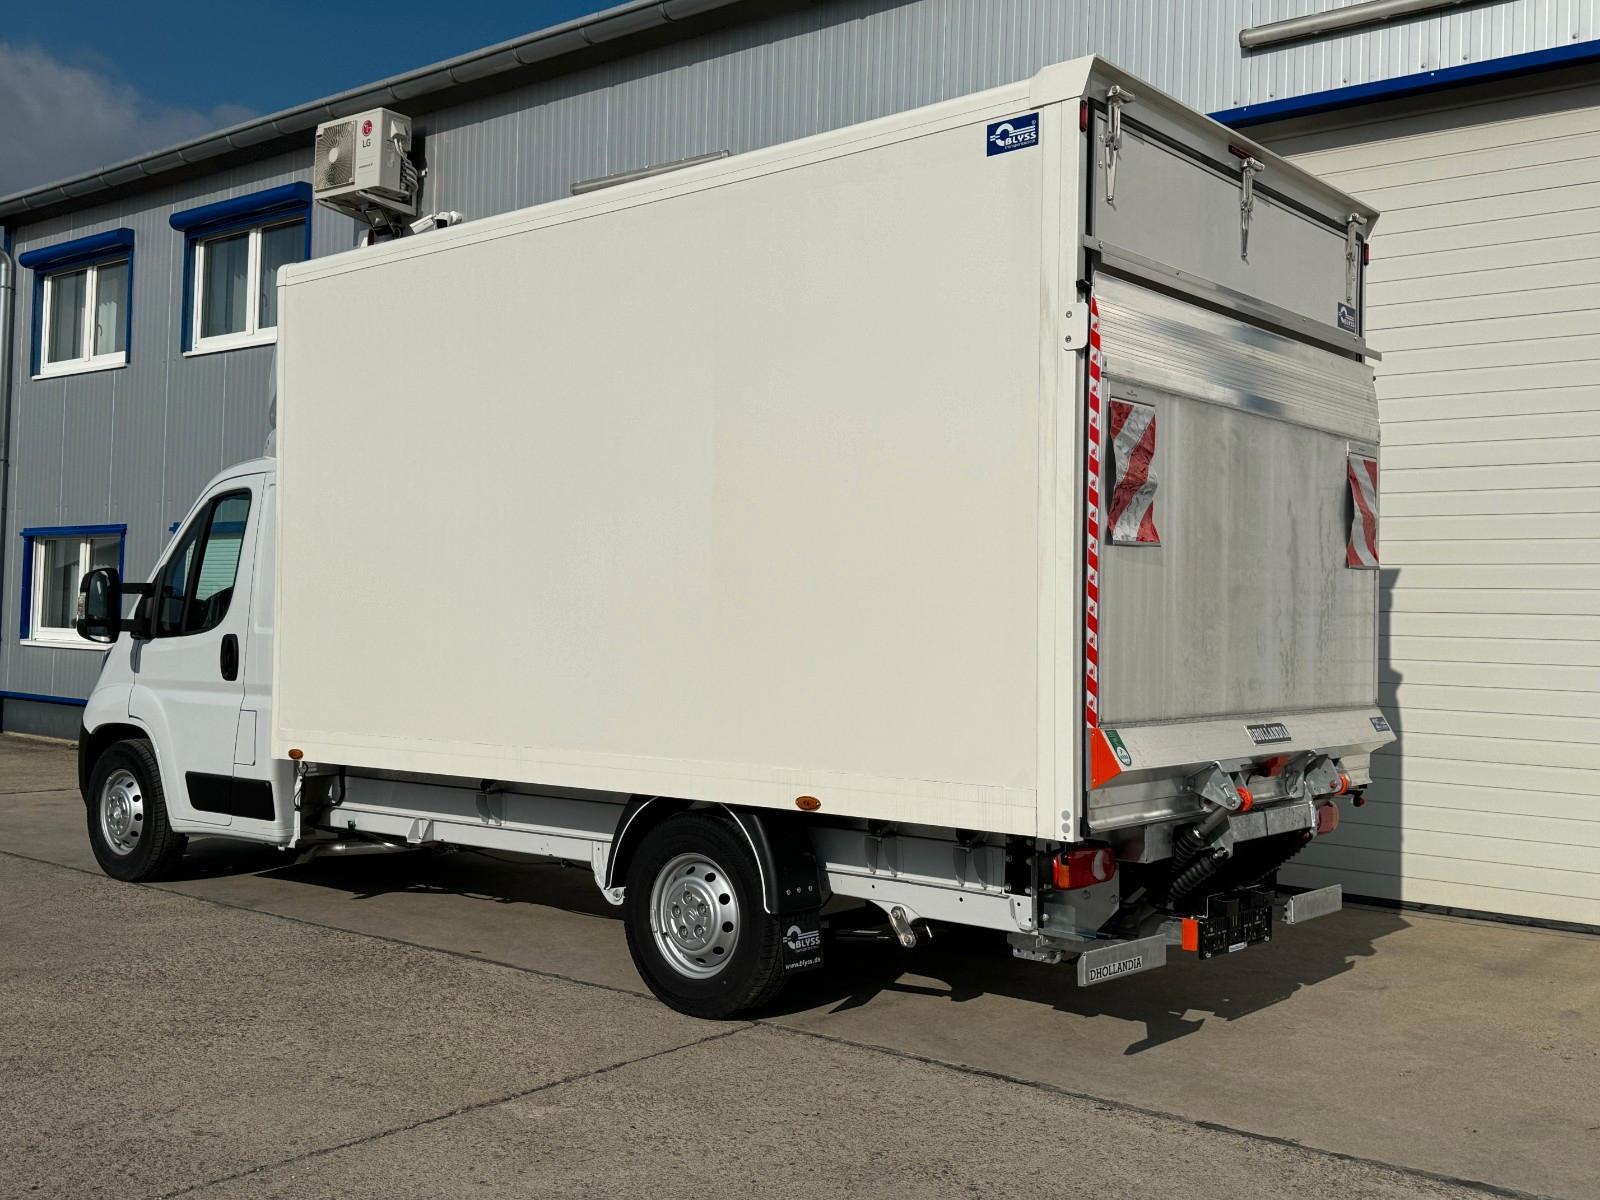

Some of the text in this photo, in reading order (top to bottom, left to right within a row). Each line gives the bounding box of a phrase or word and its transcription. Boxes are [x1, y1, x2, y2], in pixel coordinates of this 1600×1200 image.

[362, 138, 371, 148] LG
[1005, 131, 1037, 146] BLYSS
[795, 936, 821, 949] BLYSS
[1090, 957, 1142, 981] DHOLLANDIA
